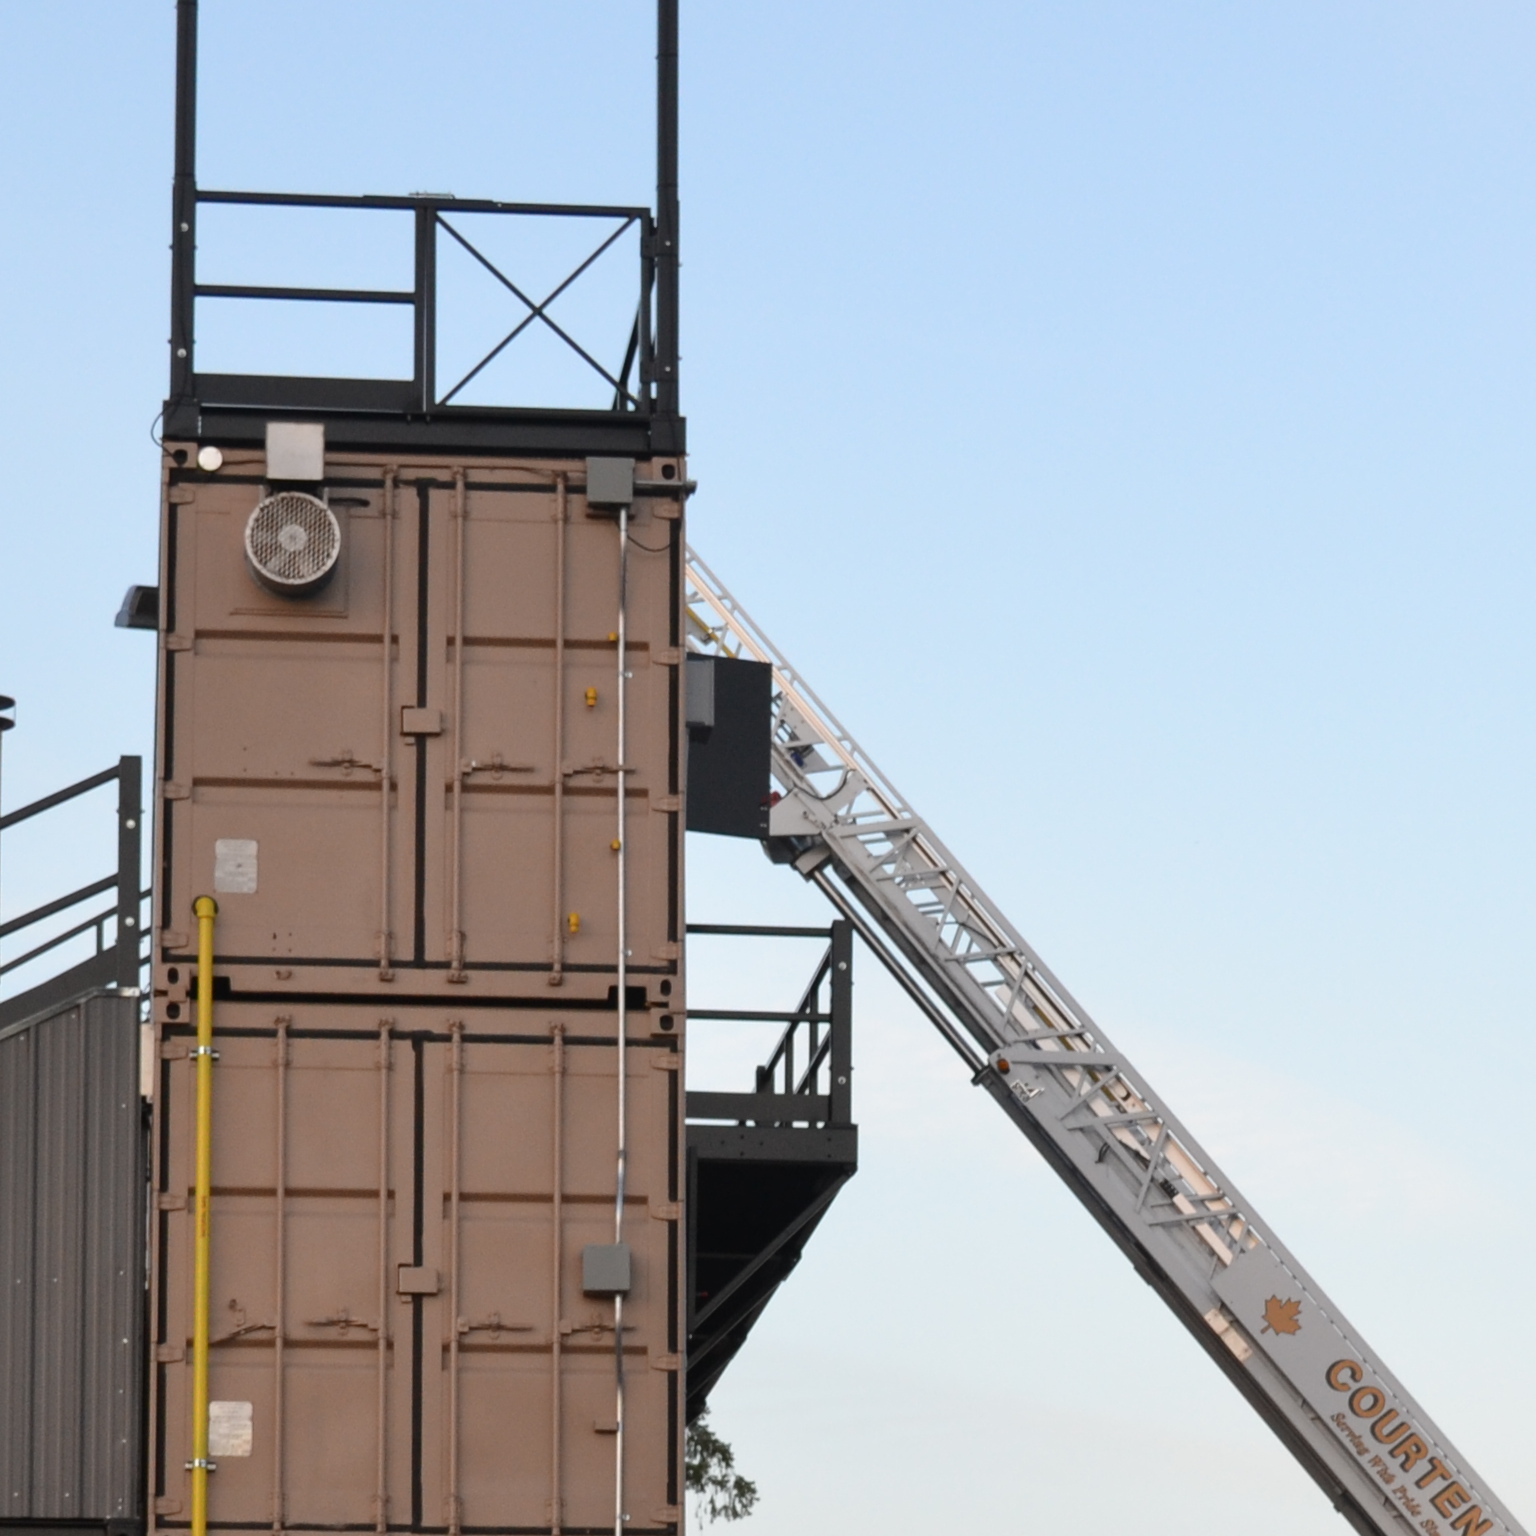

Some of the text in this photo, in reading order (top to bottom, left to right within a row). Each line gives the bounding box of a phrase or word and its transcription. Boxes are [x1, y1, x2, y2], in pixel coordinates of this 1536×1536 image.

[1330, 1412, 1370, 1457] Serving
[1368, 1454, 1396, 1485] With
[1392, 1485, 1422, 1517] Pride
